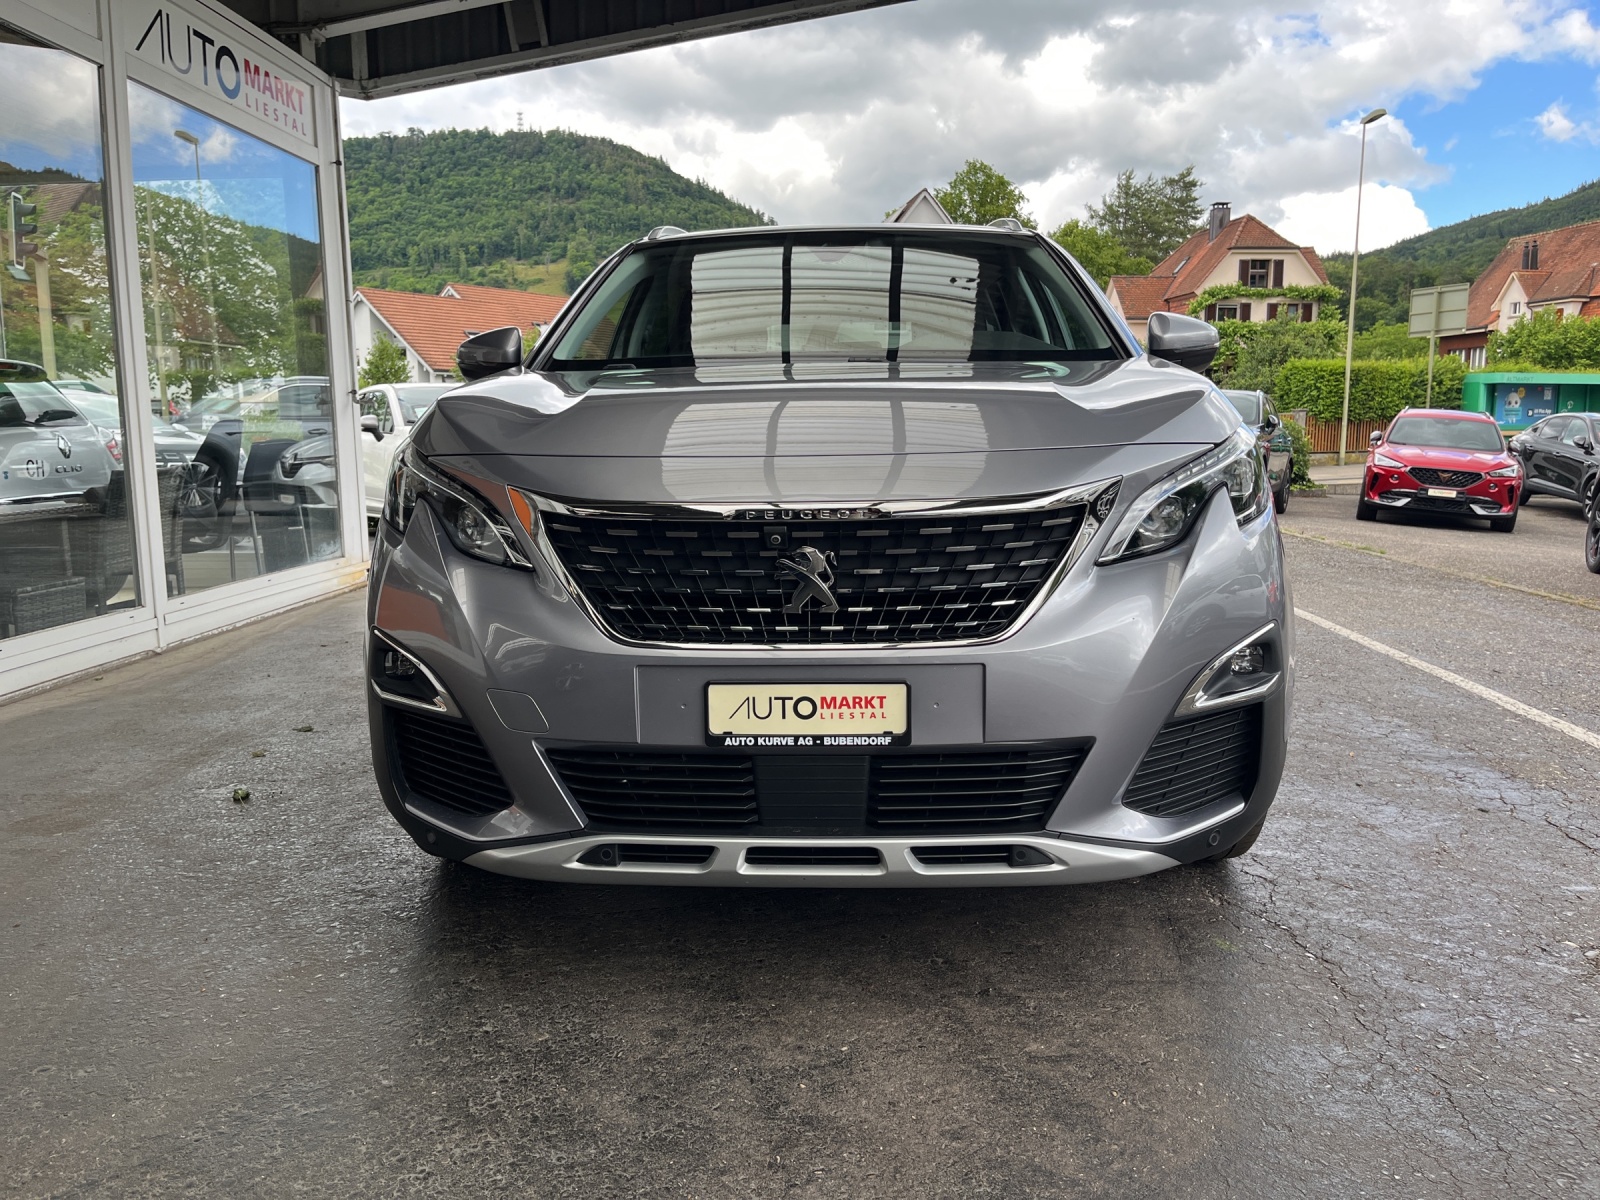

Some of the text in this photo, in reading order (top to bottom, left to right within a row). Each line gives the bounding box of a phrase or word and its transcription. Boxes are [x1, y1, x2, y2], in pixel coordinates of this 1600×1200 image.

[135, 9, 304, 115] AUTO MARKT
[245, 93, 307, 137] LIESTAL
[26, 459, 45, 478] CH
[55, 464, 83, 474] CLIO
[745, 510, 869, 520] PEUGEOT
[728, 696, 887, 720] AUTO MARKT
[820, 712, 887, 720] LIESTAL
[724, 737, 755, 746] AUTO
[757, 737, 794, 746] KURVE
[798, 737, 813, 746] AG
[823, 737, 892, 746] BUBENDORF
